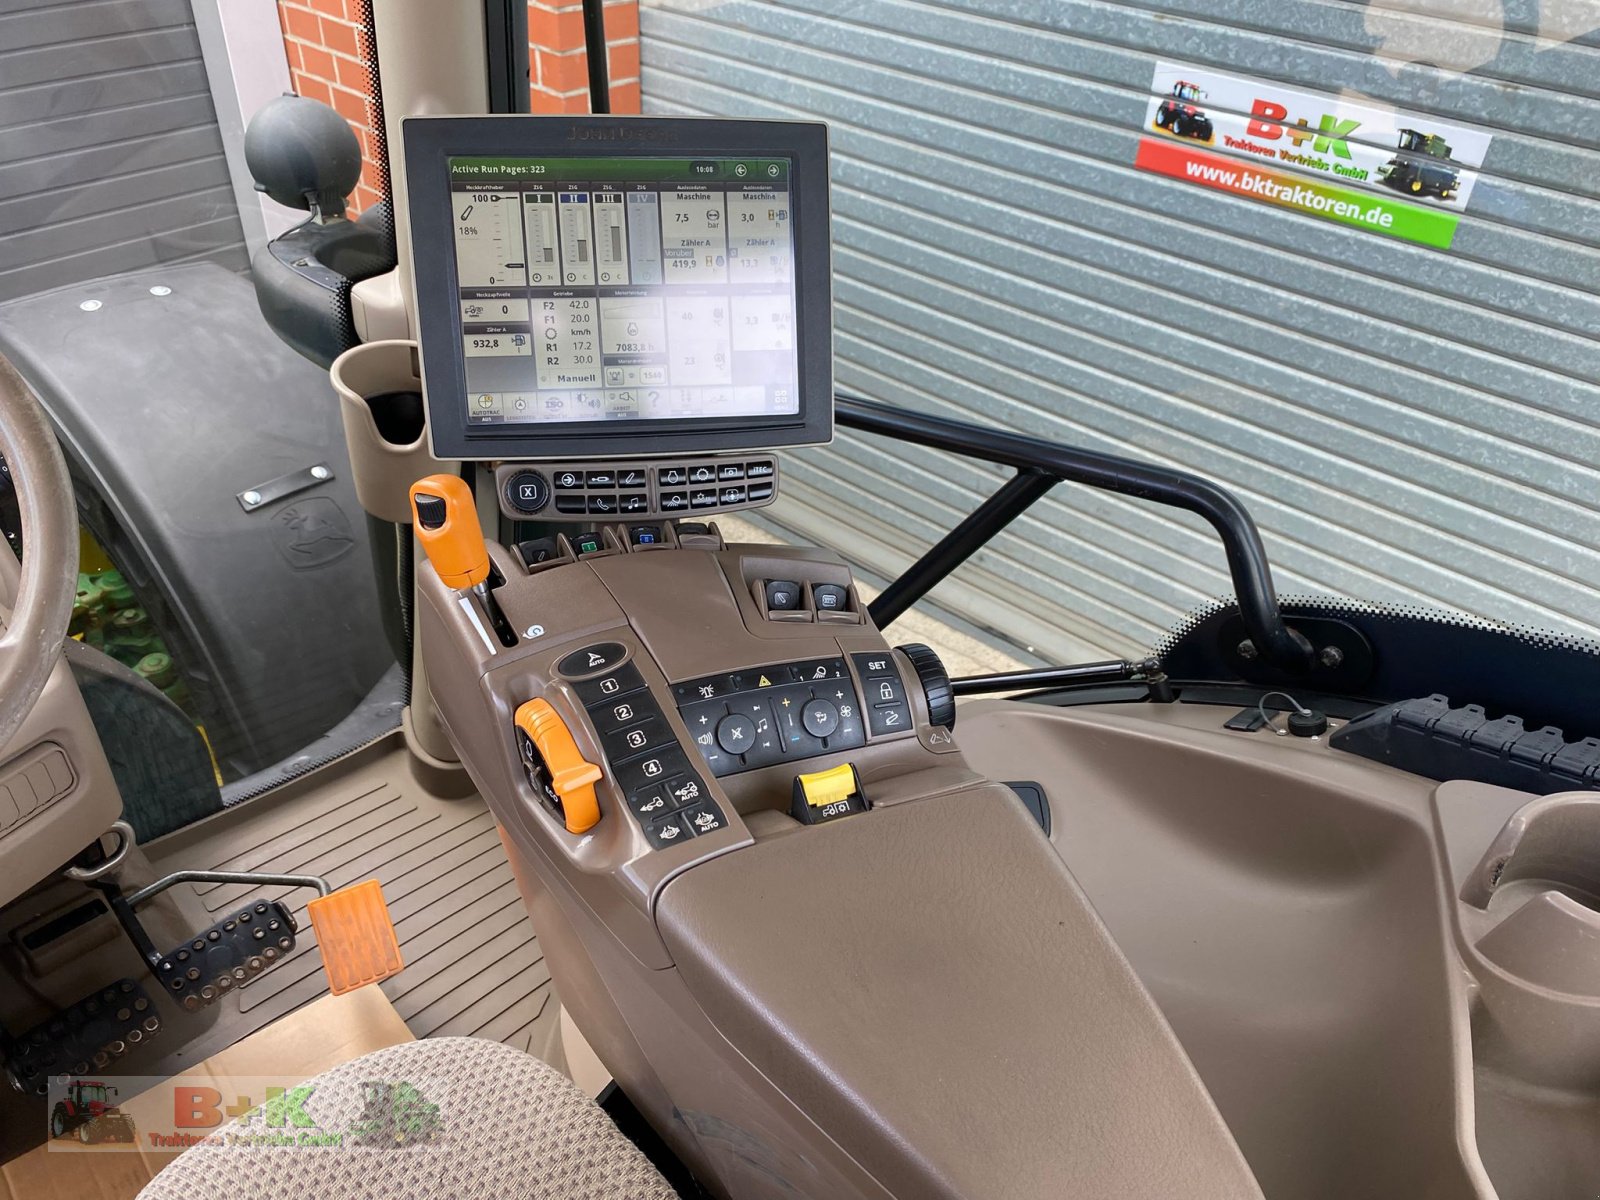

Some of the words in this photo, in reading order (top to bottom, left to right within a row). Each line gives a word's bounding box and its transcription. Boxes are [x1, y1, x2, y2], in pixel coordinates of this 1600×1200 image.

[1246, 98, 1361, 160] B+K
[1223, 135, 1276, 157] Traktoren
[1279, 149, 1330, 172] Vertriebs
[1332, 162, 1369, 182] GmbH
[452, 165, 479, 174] Active
[481, 165, 498, 174] Run
[501, 165, 529, 175] Pages:
[530, 165, 545, 174] 323
[472, 194, 488, 202] 100
[1186, 161, 1393, 227] www.bktraktoren.de
[675, 214, 689, 223] 7,5
[741, 213, 755, 223] 3,0
[459, 227, 478, 235] 18%
[681, 239, 703, 247] Zähler
[672, 260, 697, 269] 419,9
[502, 305, 508, 314] 0
[543, 302, 555, 310] F2
[569, 301, 589, 309] 42.0
[544, 316, 556, 324] F1
[571, 314, 590, 323] 20.0
[571, 328, 591, 336] km/h
[473, 339, 499, 349] 932,8
[546, 343, 558, 351] R1
[573, 342, 592, 350] 17.2
[547, 357, 560, 365] R2
[574, 355, 593, 364] 30.0
[557, 374, 596, 383] Manuell
[589, 657, 606, 667] AUTO
[868, 660, 886, 670] SET
[605, 681, 613, 690] 1
[619, 707, 628, 717] 2
[632, 734, 641, 744] 3
[648, 763, 657, 773] 4
[681, 790, 699, 801] AUTO
[701, 821, 719, 832] AUTO
